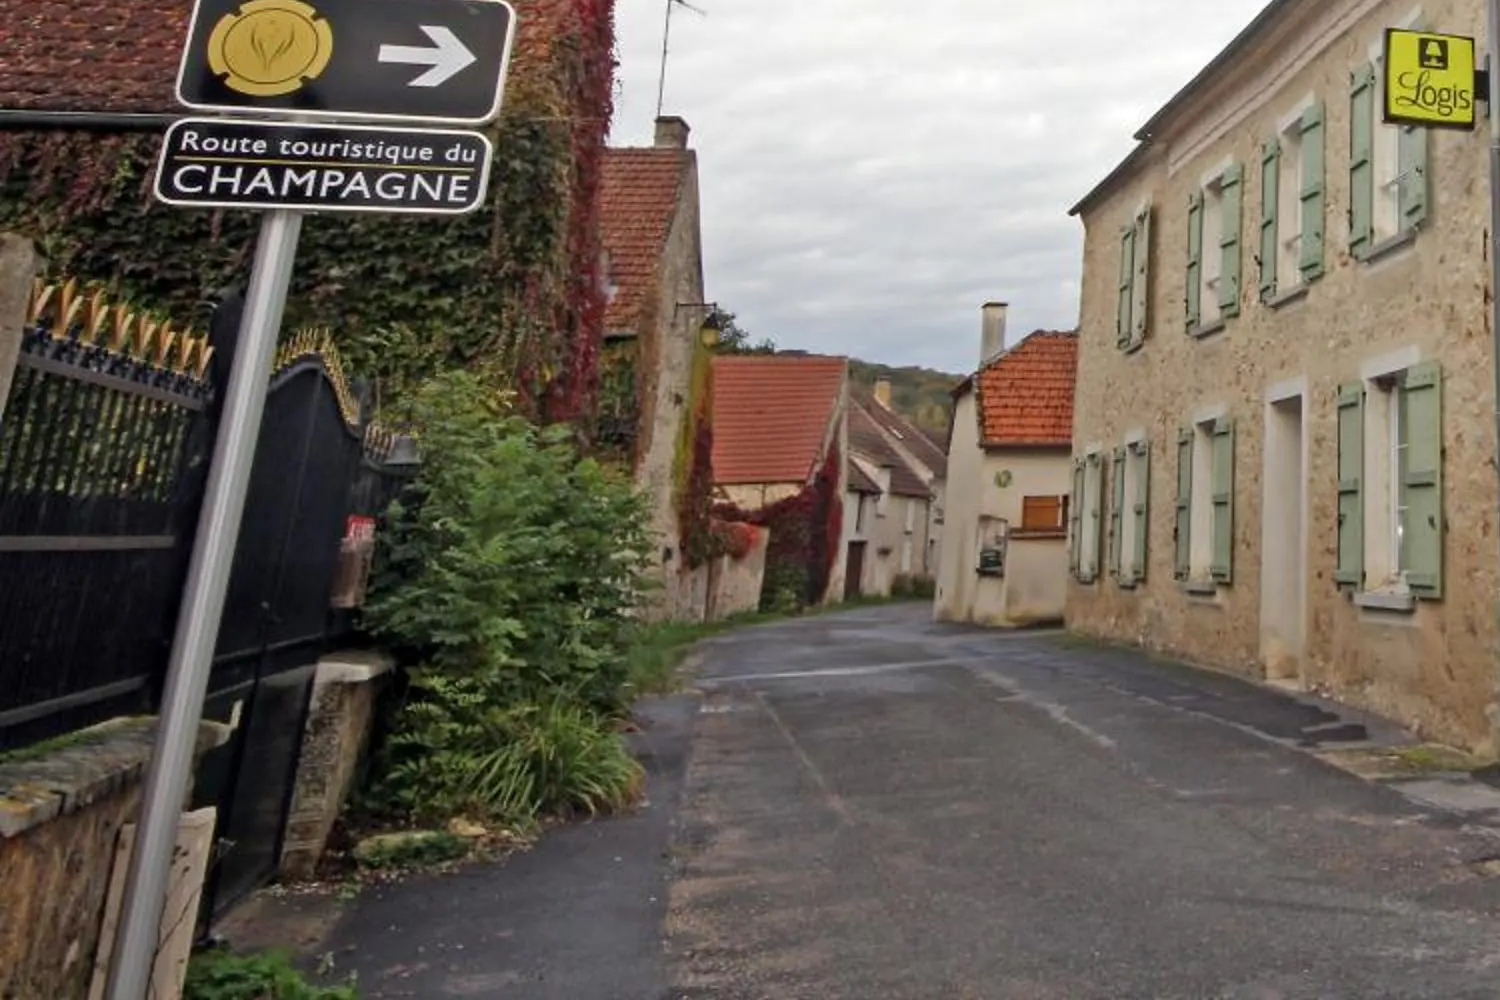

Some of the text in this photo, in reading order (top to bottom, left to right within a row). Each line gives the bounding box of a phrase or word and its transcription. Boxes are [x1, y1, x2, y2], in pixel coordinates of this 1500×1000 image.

[1395, 70, 1471, 117] Logis
[181, 131, 476, 165] Route touristique du
[172, 165, 471, 203] CHAMPAGNE
